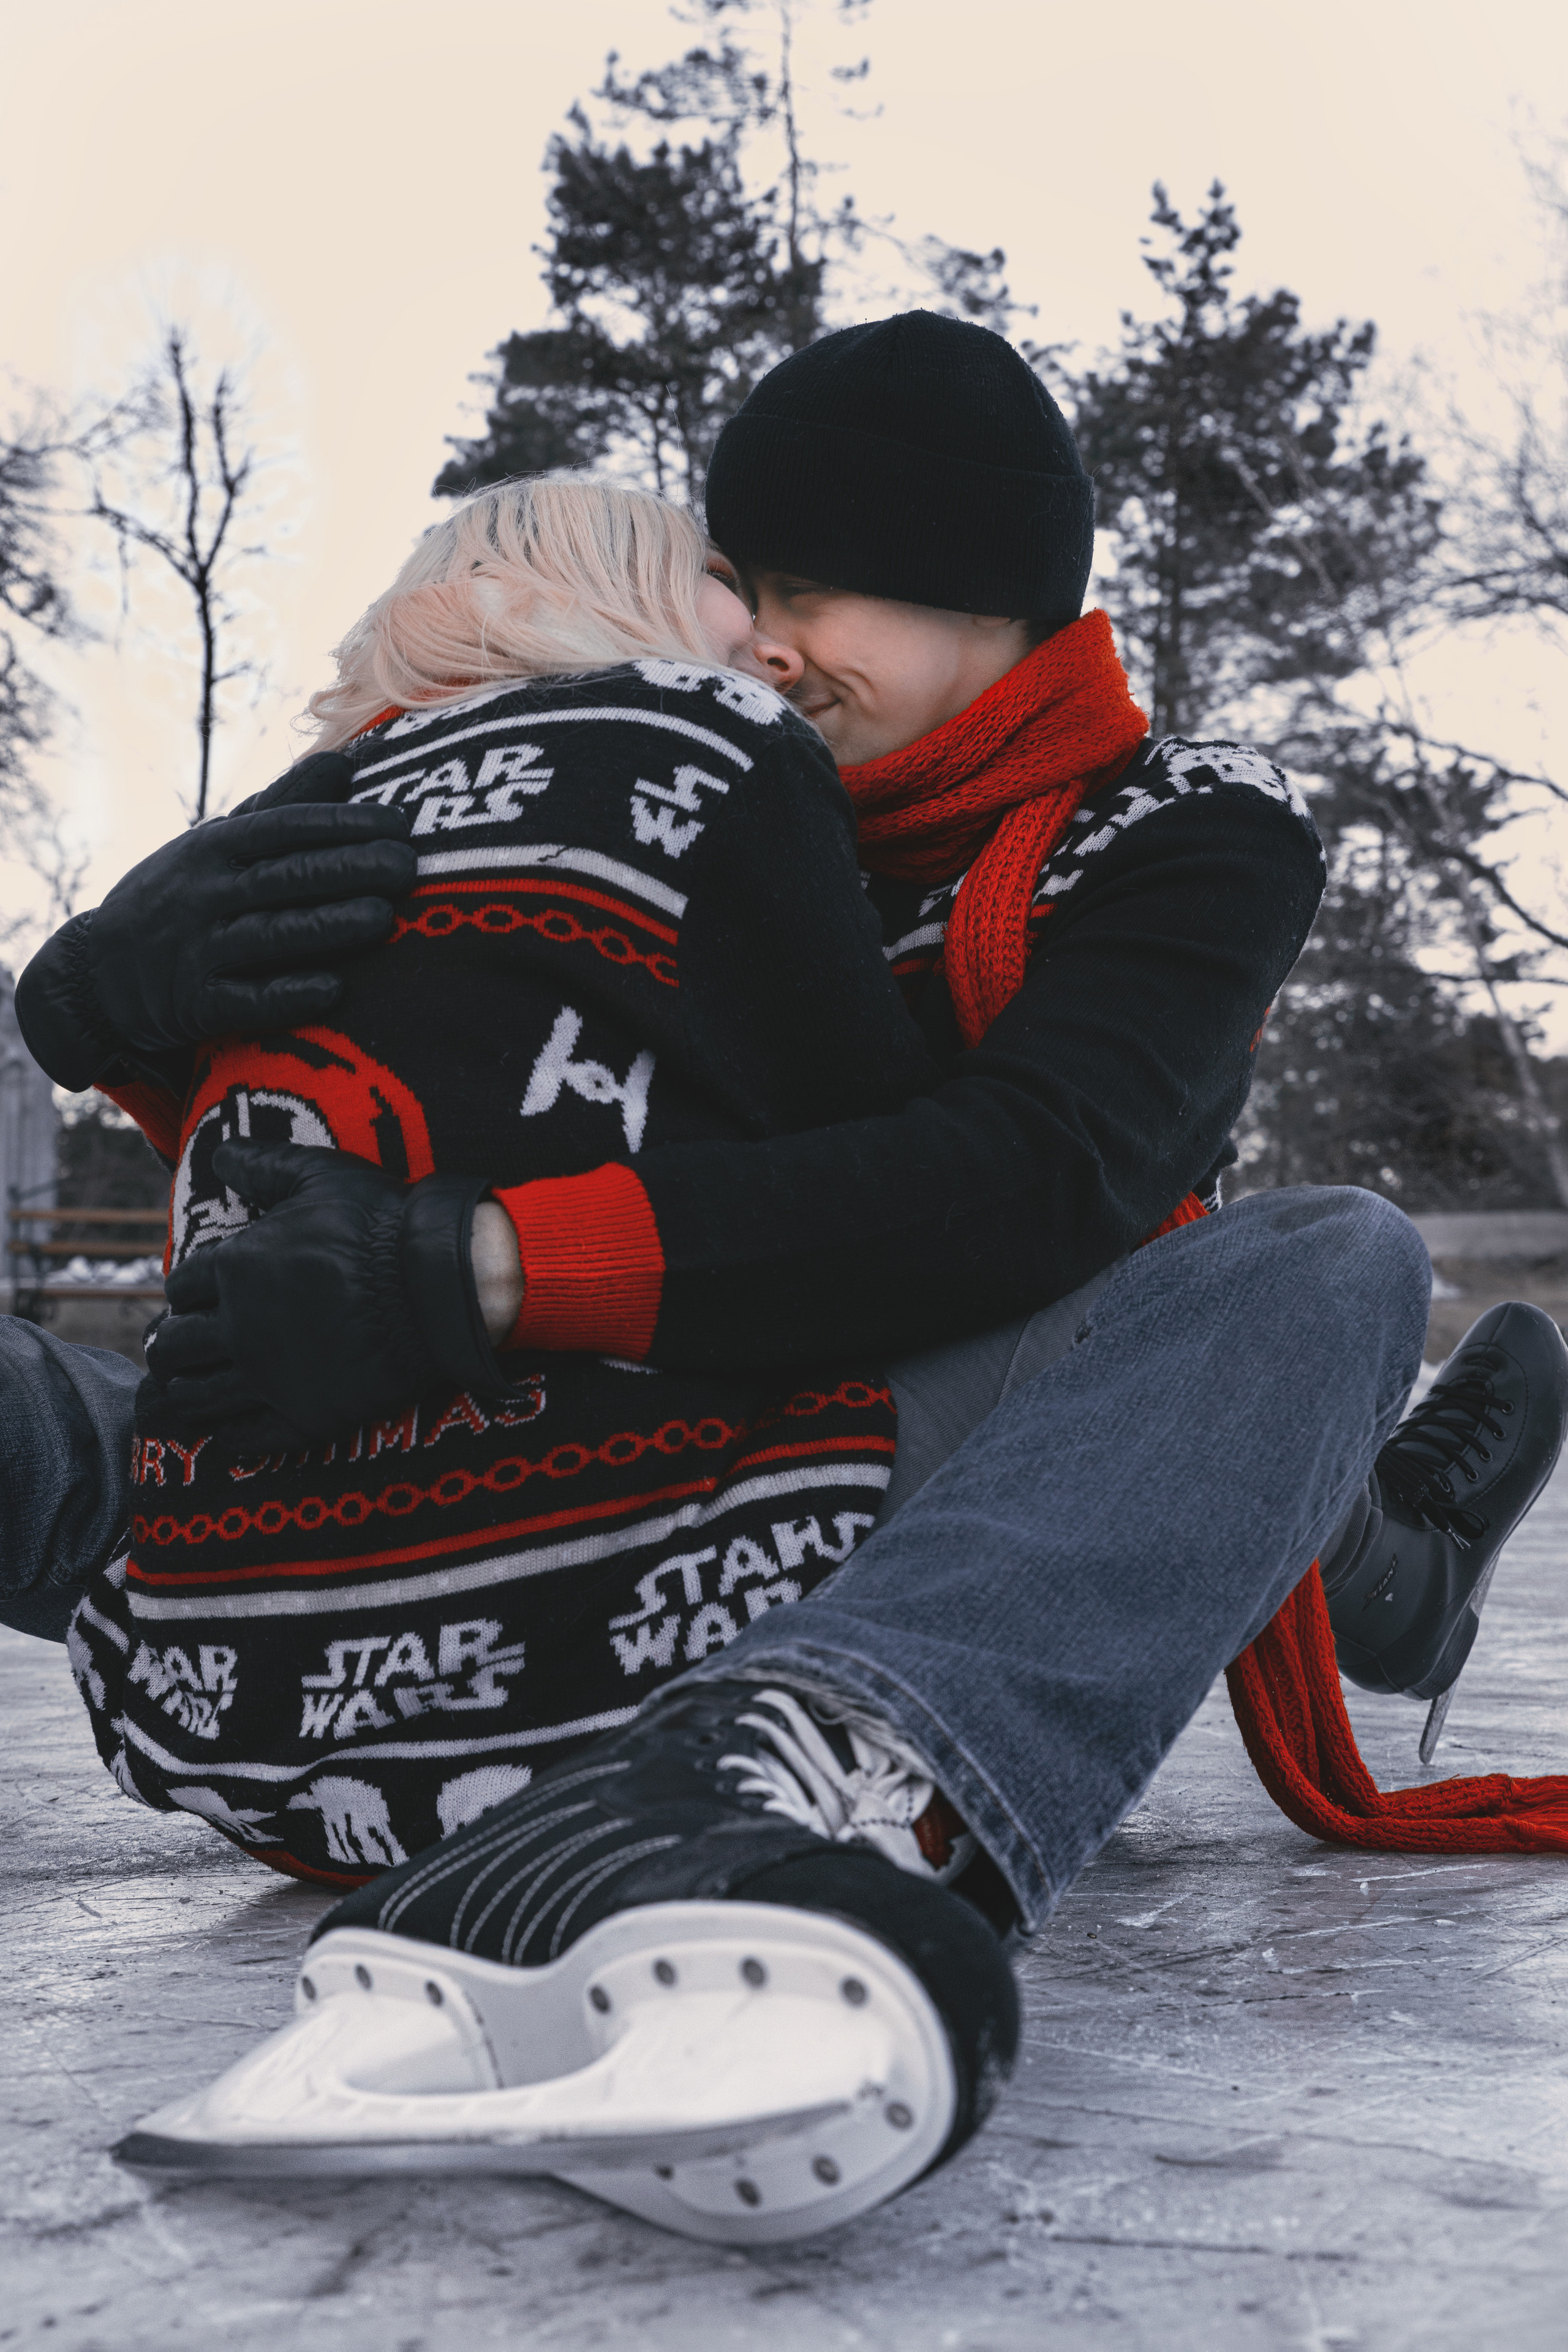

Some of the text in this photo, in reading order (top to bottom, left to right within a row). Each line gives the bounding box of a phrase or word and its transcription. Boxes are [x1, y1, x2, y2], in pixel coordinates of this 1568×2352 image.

[349, 744, 554, 805] TAR
[301, 1618, 526, 1687] STAR
[609, 1577, 802, 1676] WAR
[299, 1656, 526, 1741] WARS
